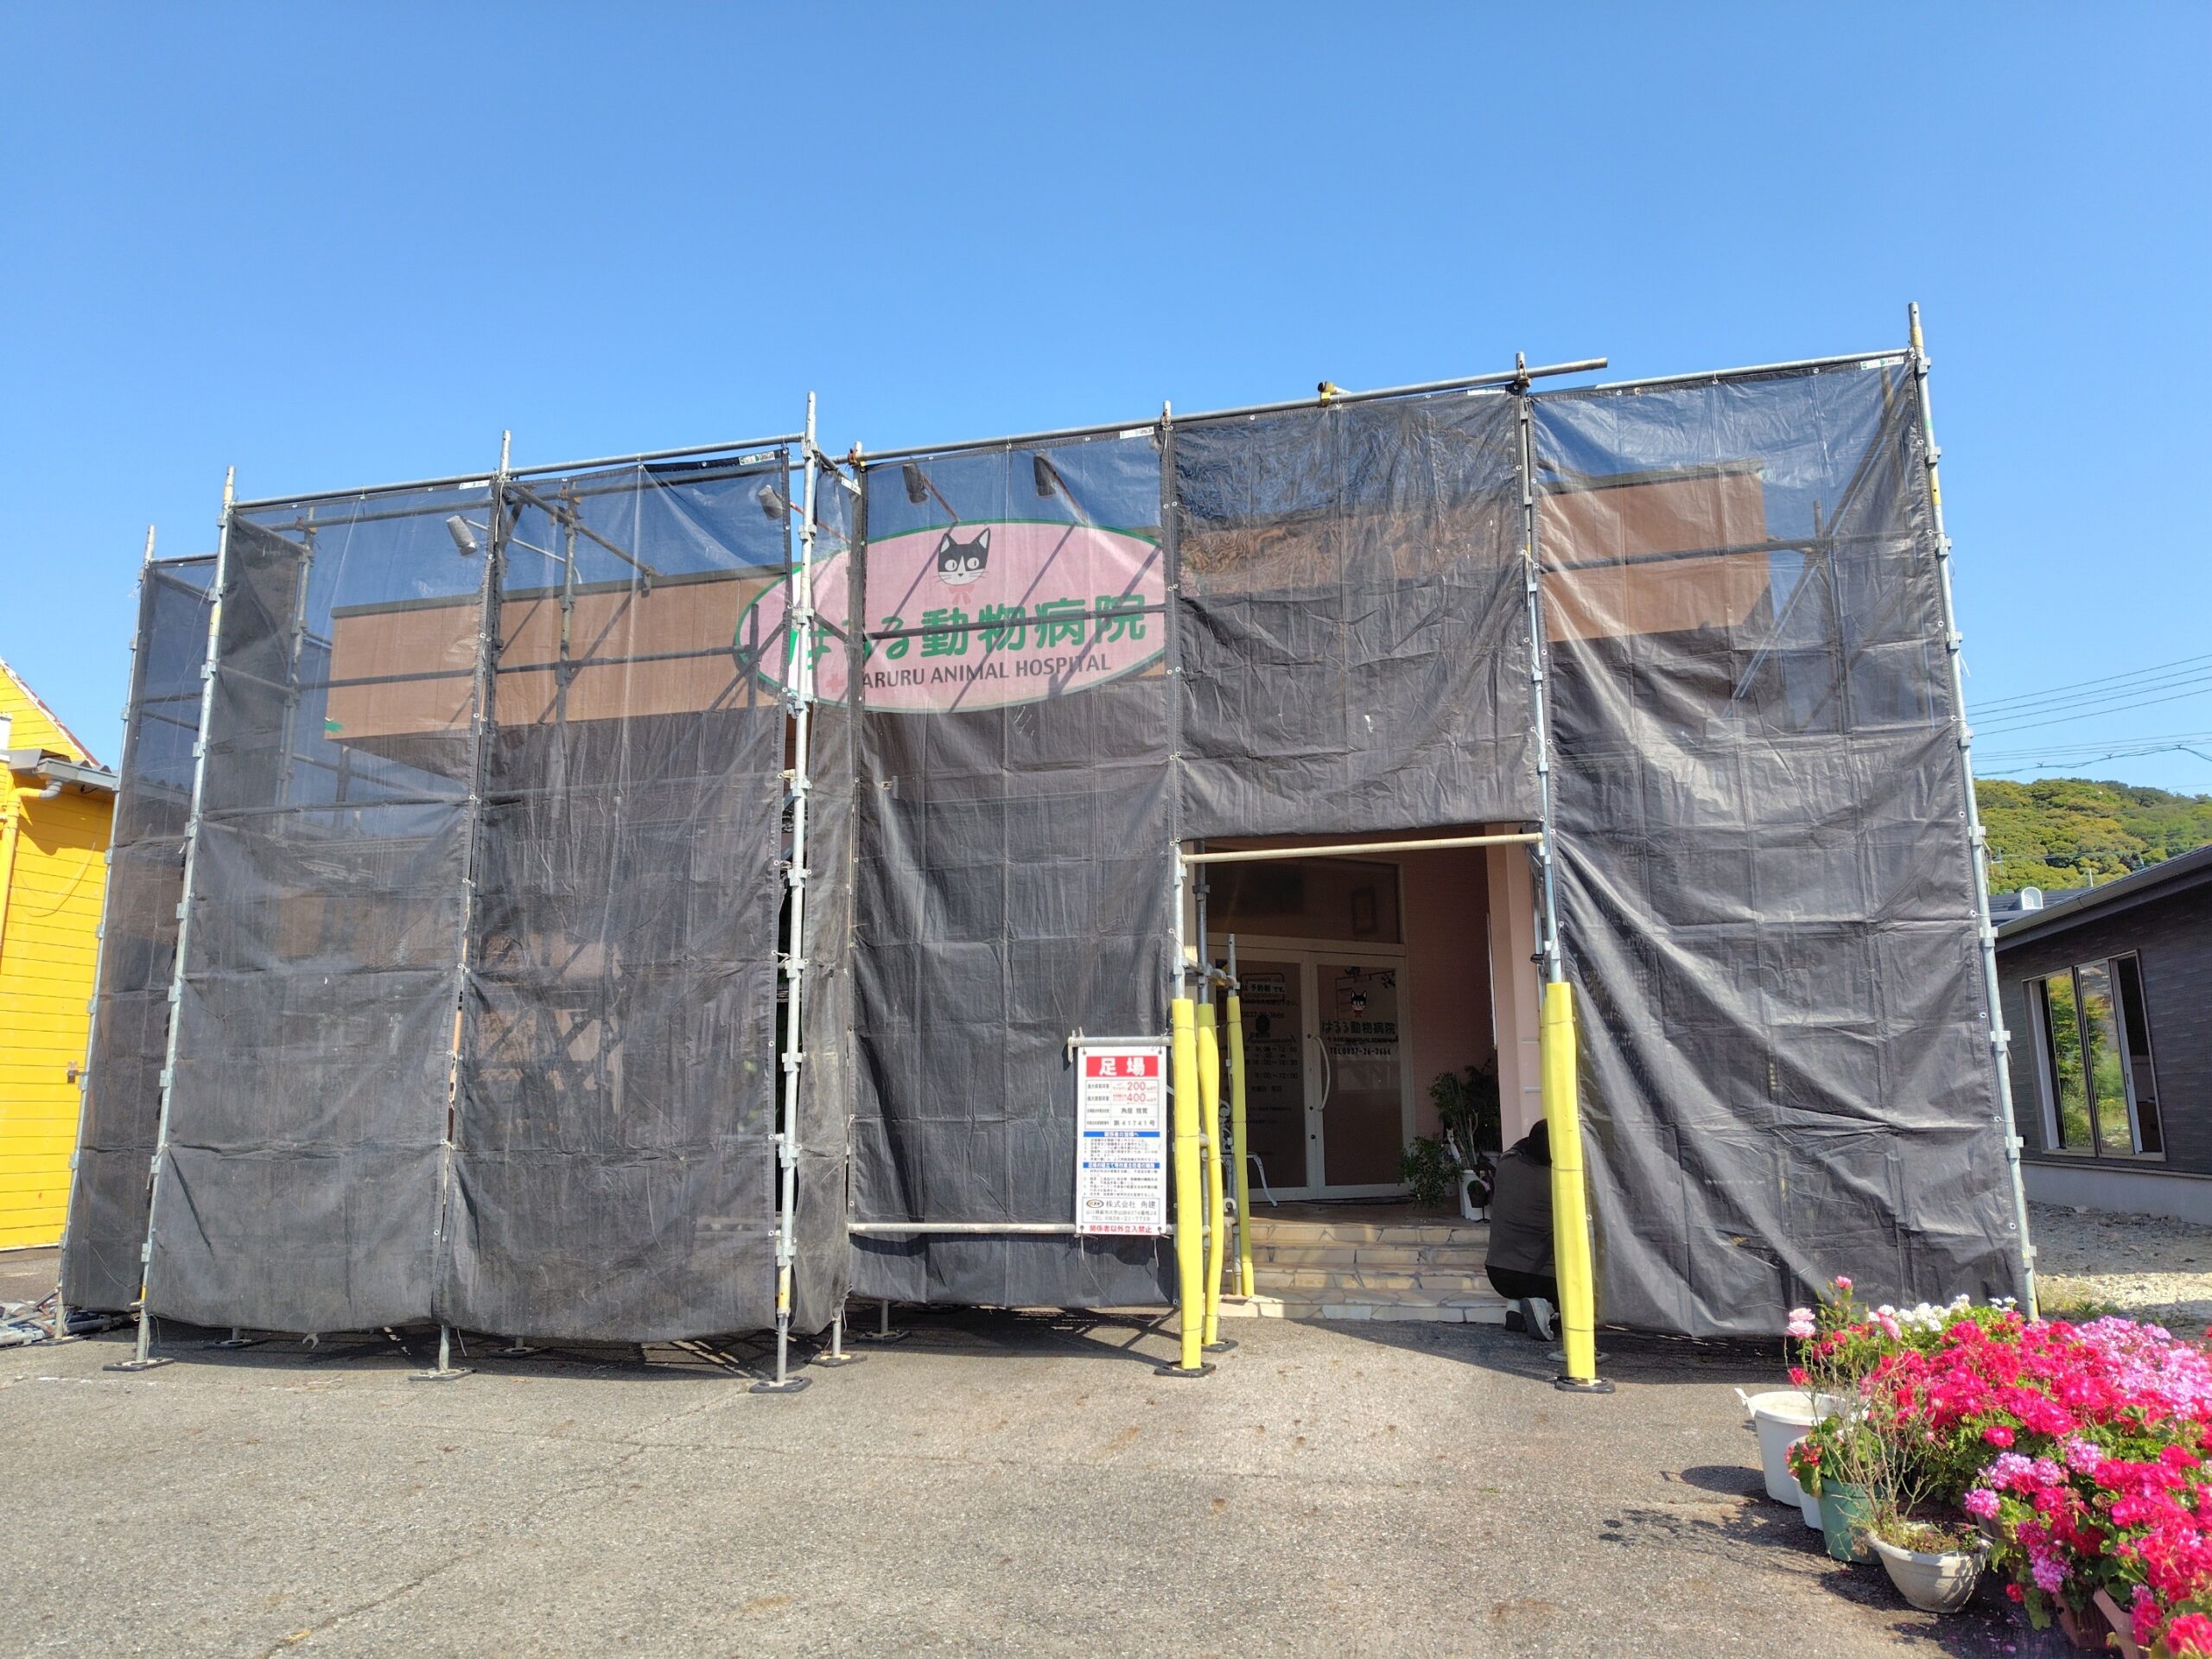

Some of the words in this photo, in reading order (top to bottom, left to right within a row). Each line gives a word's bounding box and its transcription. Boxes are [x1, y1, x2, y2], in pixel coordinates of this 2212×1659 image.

[931, 661, 1009, 683] ANIMAL
[1015, 653, 1112, 677] HOSPITAL
[1099, 1057, 1145, 1077] 足場
[1127, 1081, 1146, 1090] 200
[1127, 1093, 1146, 1103] 400
[1089, 1224, 1153, 1234] 関係者以外立入禁止
